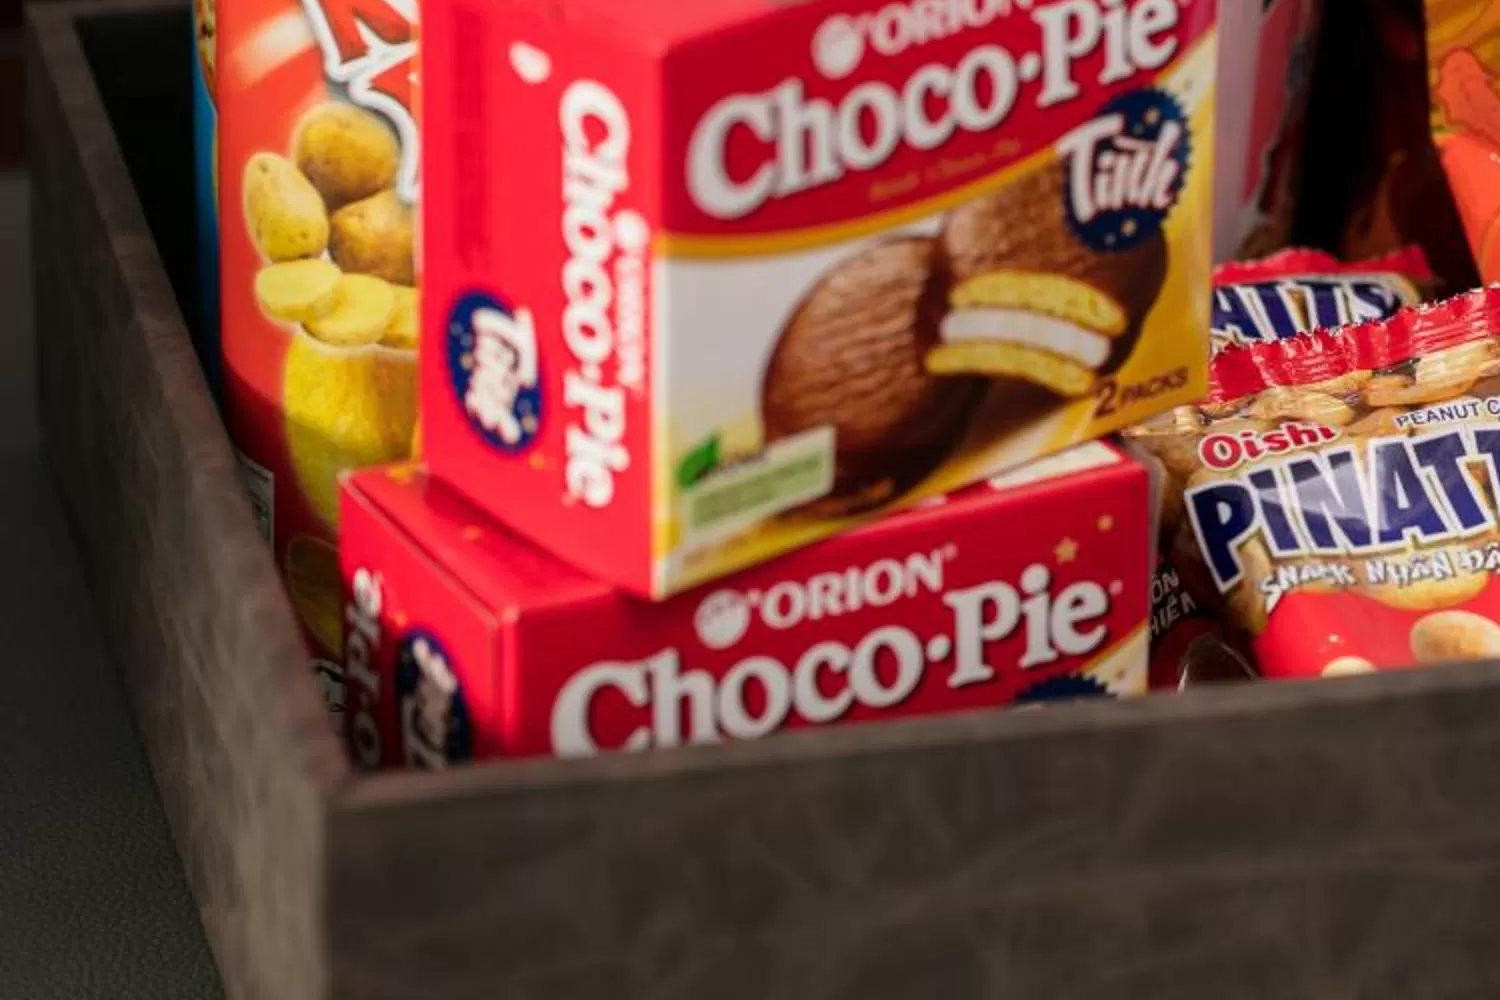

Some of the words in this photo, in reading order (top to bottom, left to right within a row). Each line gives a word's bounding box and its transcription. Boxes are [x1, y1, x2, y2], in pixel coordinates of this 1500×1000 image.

[1093, 385, 1121, 418] 2
[1121, 366, 1190, 408] PACKS
[1396, 400, 1481, 429] PEANUT
[1200, 423, 1336, 470] Oishi
[758, 551, 945, 630] ORION
